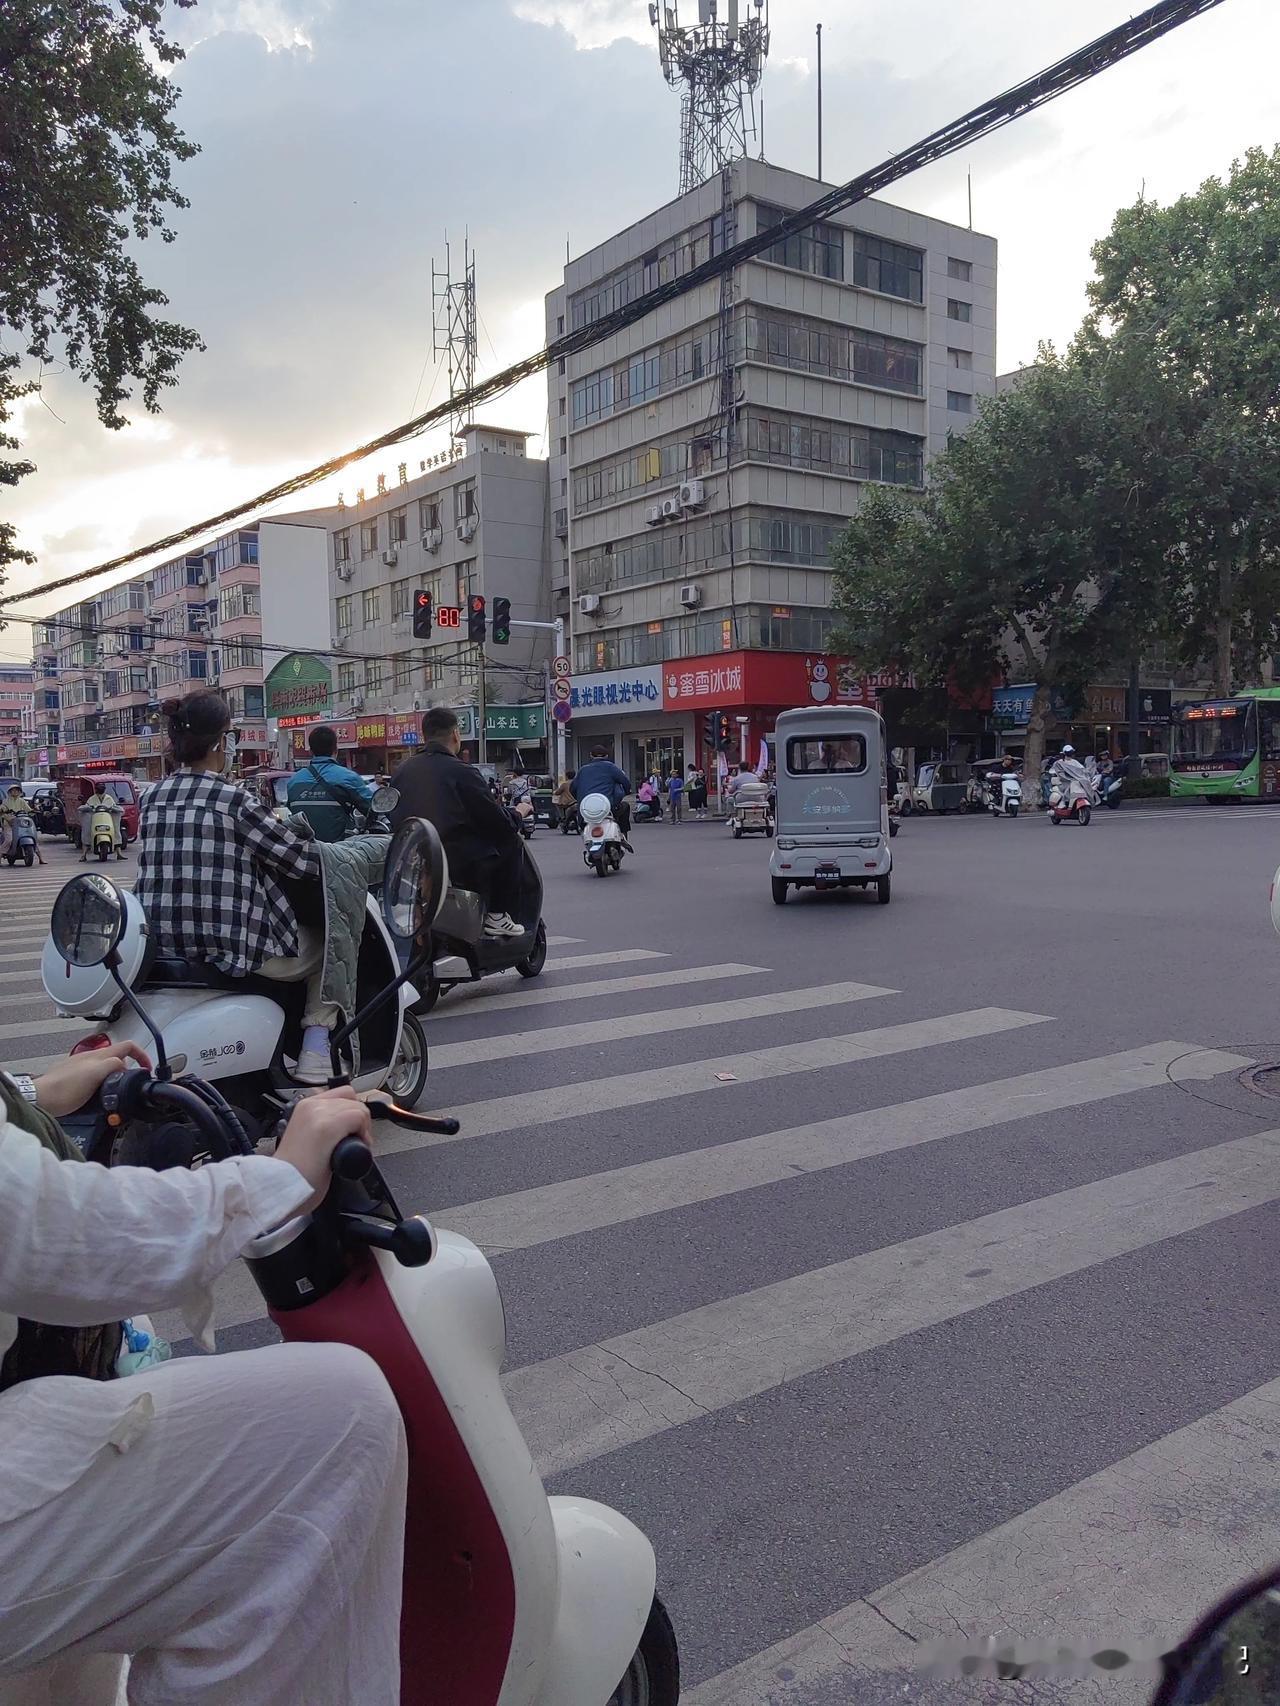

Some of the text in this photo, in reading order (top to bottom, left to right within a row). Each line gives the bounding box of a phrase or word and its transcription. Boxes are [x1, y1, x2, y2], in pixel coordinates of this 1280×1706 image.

[438, 608, 460, 627] 80
[556, 662, 568, 671] 50
[680, 665, 742, 697] 蜜雪冰城
[528, 713, 537, 727] 茶
